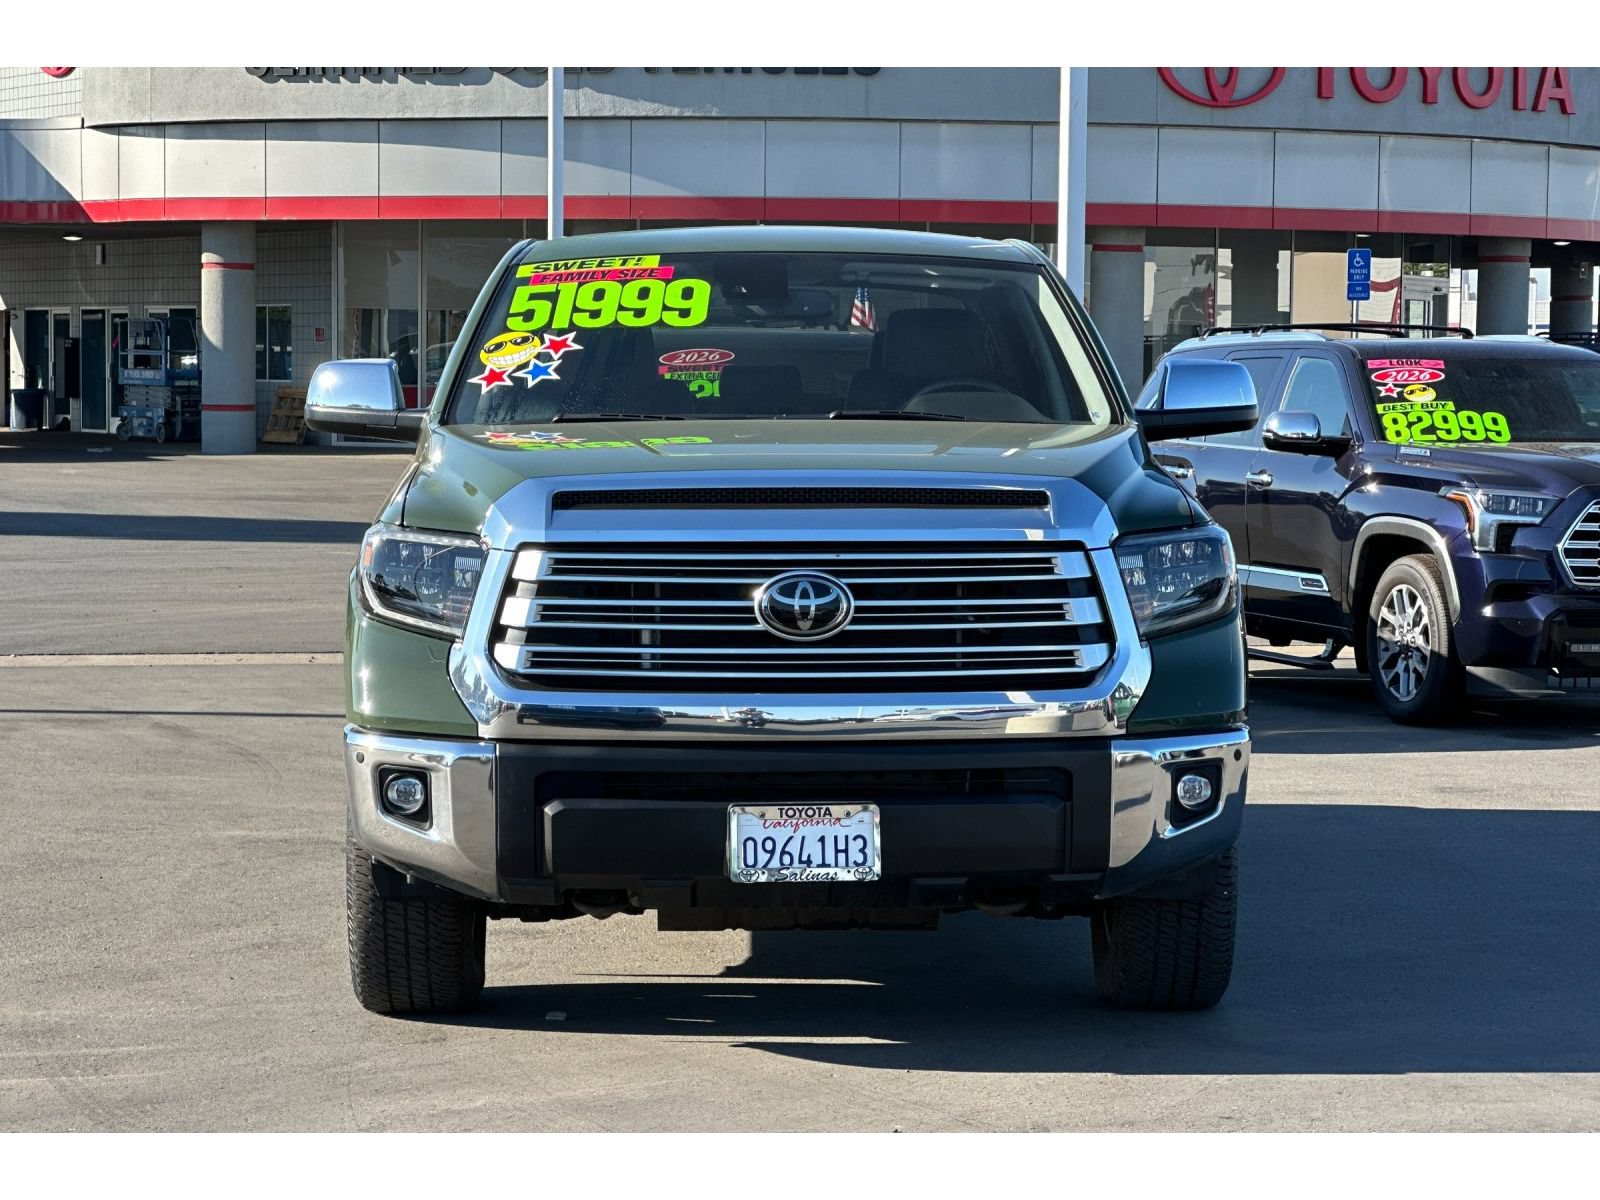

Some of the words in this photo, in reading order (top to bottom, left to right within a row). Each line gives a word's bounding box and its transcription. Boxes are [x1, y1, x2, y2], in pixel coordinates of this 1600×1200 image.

[532, 257, 643, 273] SWEET!
[540, 270, 610, 283] FAMILY
[618, 268, 661, 279] SIZE
[506, 279, 711, 331] 51999
[672, 351, 721, 363] 2026
[1389, 359, 1423, 367] LOOK
[1387, 369, 1432, 382] 2026
[1382, 403, 1416, 412] BEST
[1420, 402, 1449, 410] BUY
[1382, 410, 1512, 443] 82999
[778, 807, 833, 818] TOYOTA
[742, 834, 868, 869] 09641H3
[775, 867, 839, 882] Salinas
